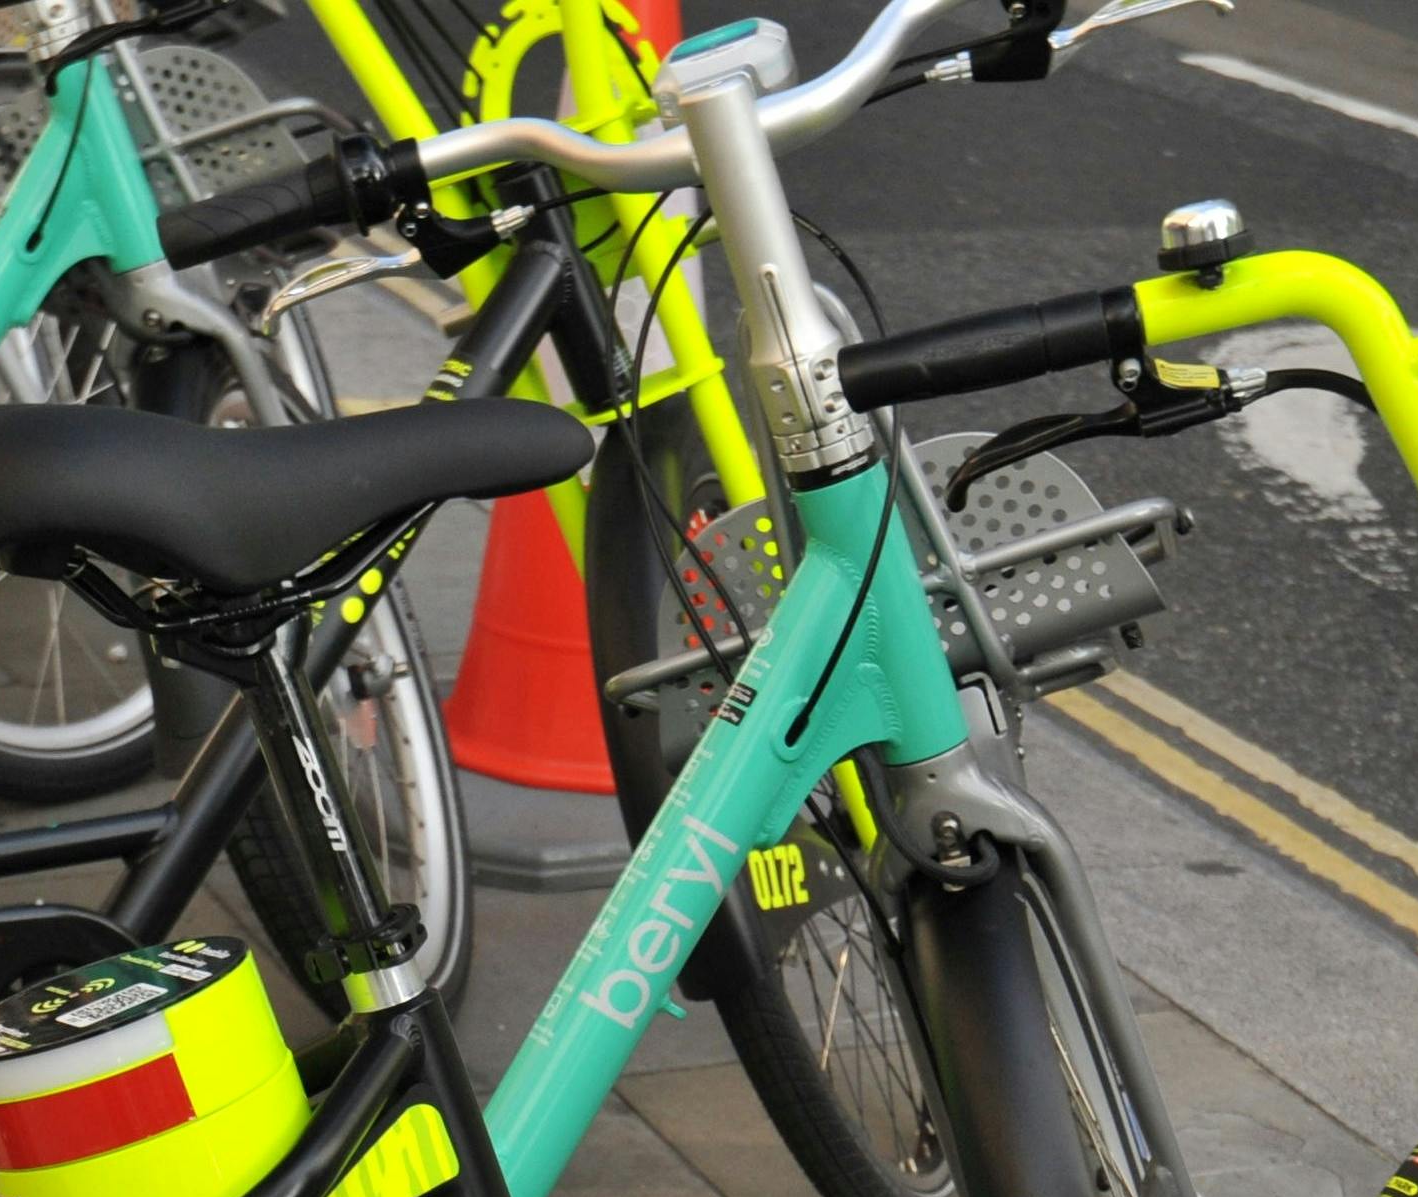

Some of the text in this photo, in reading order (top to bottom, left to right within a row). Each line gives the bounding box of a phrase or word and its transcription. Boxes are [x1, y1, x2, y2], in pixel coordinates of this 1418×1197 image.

[291, 735, 348, 852] ZOOM
[579, 815, 741, 1030] beryl
[748, 843, 809, 910] 0172
